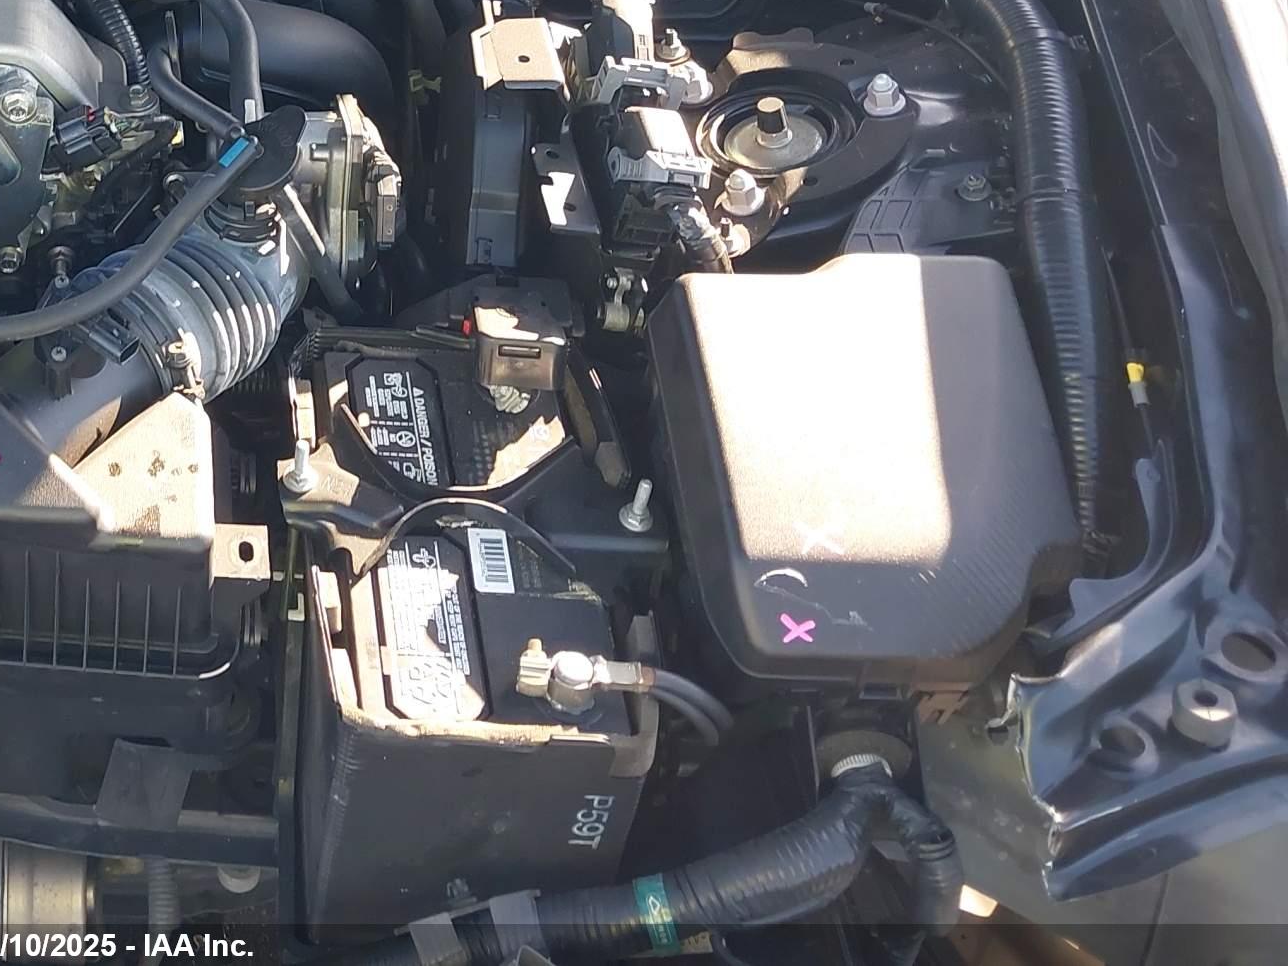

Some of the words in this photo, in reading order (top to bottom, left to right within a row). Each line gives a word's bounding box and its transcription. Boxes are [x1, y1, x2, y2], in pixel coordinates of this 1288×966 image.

[414, 397, 430, 439] DANGER
[421, 447, 439, 487] POISON
[568, 794, 615, 850] P59T
